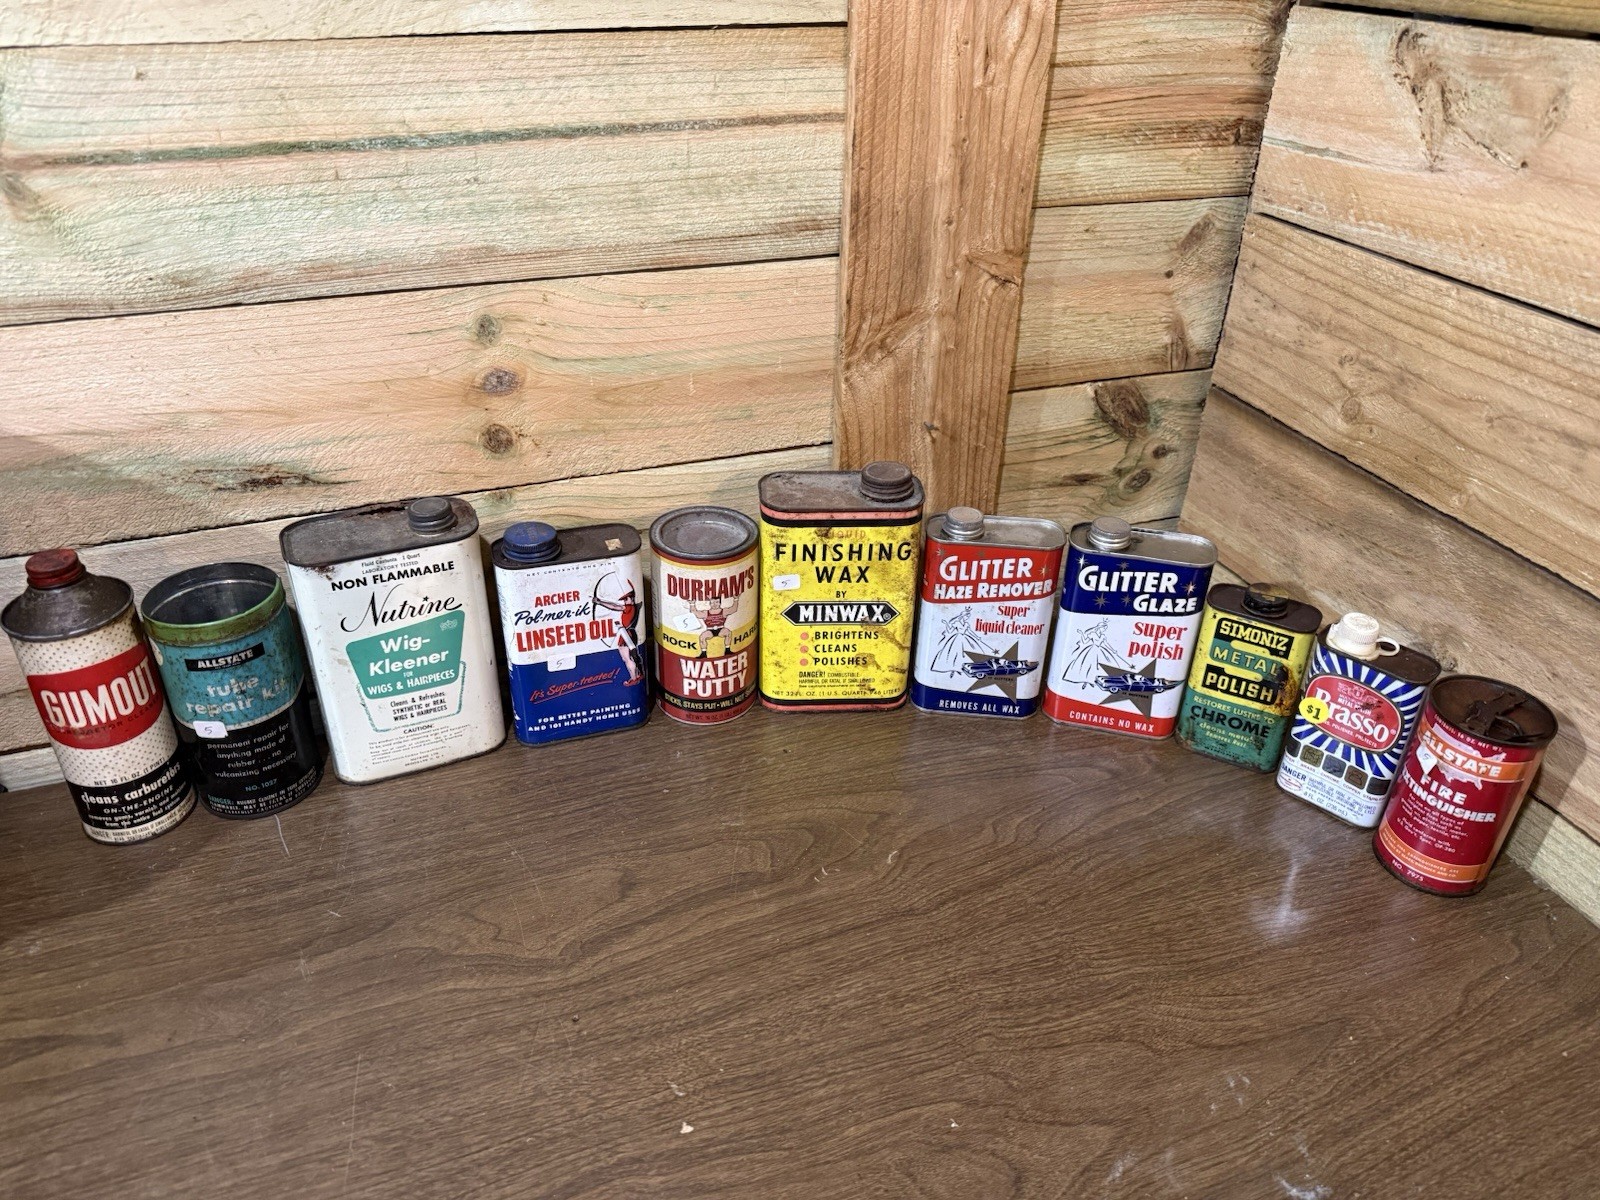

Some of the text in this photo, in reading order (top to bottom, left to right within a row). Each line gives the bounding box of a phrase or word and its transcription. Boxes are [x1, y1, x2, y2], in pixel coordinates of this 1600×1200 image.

[775, 542, 912, 561] FINISHING
[331, 561, 455, 592] NON FLAMMABLE
[362, 564, 398, 574] LABORATORY
[815, 566, 870, 583] WAX
[939, 555, 1033, 582] GLITTER
[1078, 565, 1179, 594] GLITTER
[667, 565, 755, 601] DURHAM'S
[934, 579, 1053, 600] HAZE REMOVER
[534, 590, 581, 608] ARCHER
[836, 590, 847, 599] BY
[1133, 594, 1198, 613] GLAZE
[340, 583, 463, 632] Nutrine
[514, 602, 592, 627] Pol-mer-ik
[799, 604, 885, 623] MINWAX
[997, 604, 1031, 618] super
[516, 618, 617, 653] LINSEED OIL
[662, 622, 758, 651] ROCK HARD
[814, 631, 879, 640] BRIGHTENS
[975, 618, 1045, 636] liquid cleaner
[1133, 621, 1188, 641] super
[1219, 620, 1289, 652] SIMONIZ
[379, 634, 431, 655] Wig-
[814, 644, 857, 653] CLEANS
[1127, 641, 1184, 660] polish
[198, 649, 254, 669] ALLSTATE
[369, 649, 449, 677] Kleener
[680, 651, 748, 679] WATER
[814, 656, 868, 666] POLISHES
[1213, 646, 1279, 677] METAL
[40, 655, 157, 729] GUMOUT
[367, 669, 456, 696] WIGS & HAIRPIECES
[530, 668, 620, 702] It's Super-treated!
[682, 669, 748, 698] PUTTY
[1205, 672, 1274, 702] POLISH
[186, 695, 254, 717] repair
[390, 699, 409, 708] Cleans
[419, 691, 446, 702] Refreshes
[392, 703, 423, 716] SYNTHETIC
[433, 698, 447, 706] REAL
[683, 701, 703, 710] STAYS
[704, 702, 716, 710] PUT
[939, 700, 1021, 714] REMOVES ALL WAX
[1193, 695, 1232, 712] RESTORES
[1264, 716, 1275, 724] TO
[393, 714, 408, 722] WIGS
[416, 705, 448, 717] HAIRPIECES
[528, 723, 547, 732] AND
[564, 717, 593, 727] HANDY
[596, 711, 620, 721] HOME
[621, 707, 641, 716] USES
[538, 703, 631, 724] FOR BETTER PAINTING
[1069, 710, 1154, 732] CONTAINS NO WAX
[1190, 705, 1271, 738] CHROME
[1307, 704, 1321, 720] $1
[1316, 688, 1389, 742] Brasso
[204, 726, 213, 735] 5
[207, 722, 290, 750] permanent repair for
[1200, 722, 1226, 735] cleans
[216, 734, 286, 760] anything made of
[1423, 730, 1502, 777] ALLSTATE
[215, 750, 297, 779] vulcanizing necessary
[227, 759, 256, 769] rubber
[1281, 763, 1307, 781] DANGER
[81, 762, 181, 805] cleans carburetors
[1401, 766, 1497, 823] EXTINGUISHER
[1420, 772, 1467, 805] FIRE
[103, 784, 174, 814] ON-THE-ENGINE
